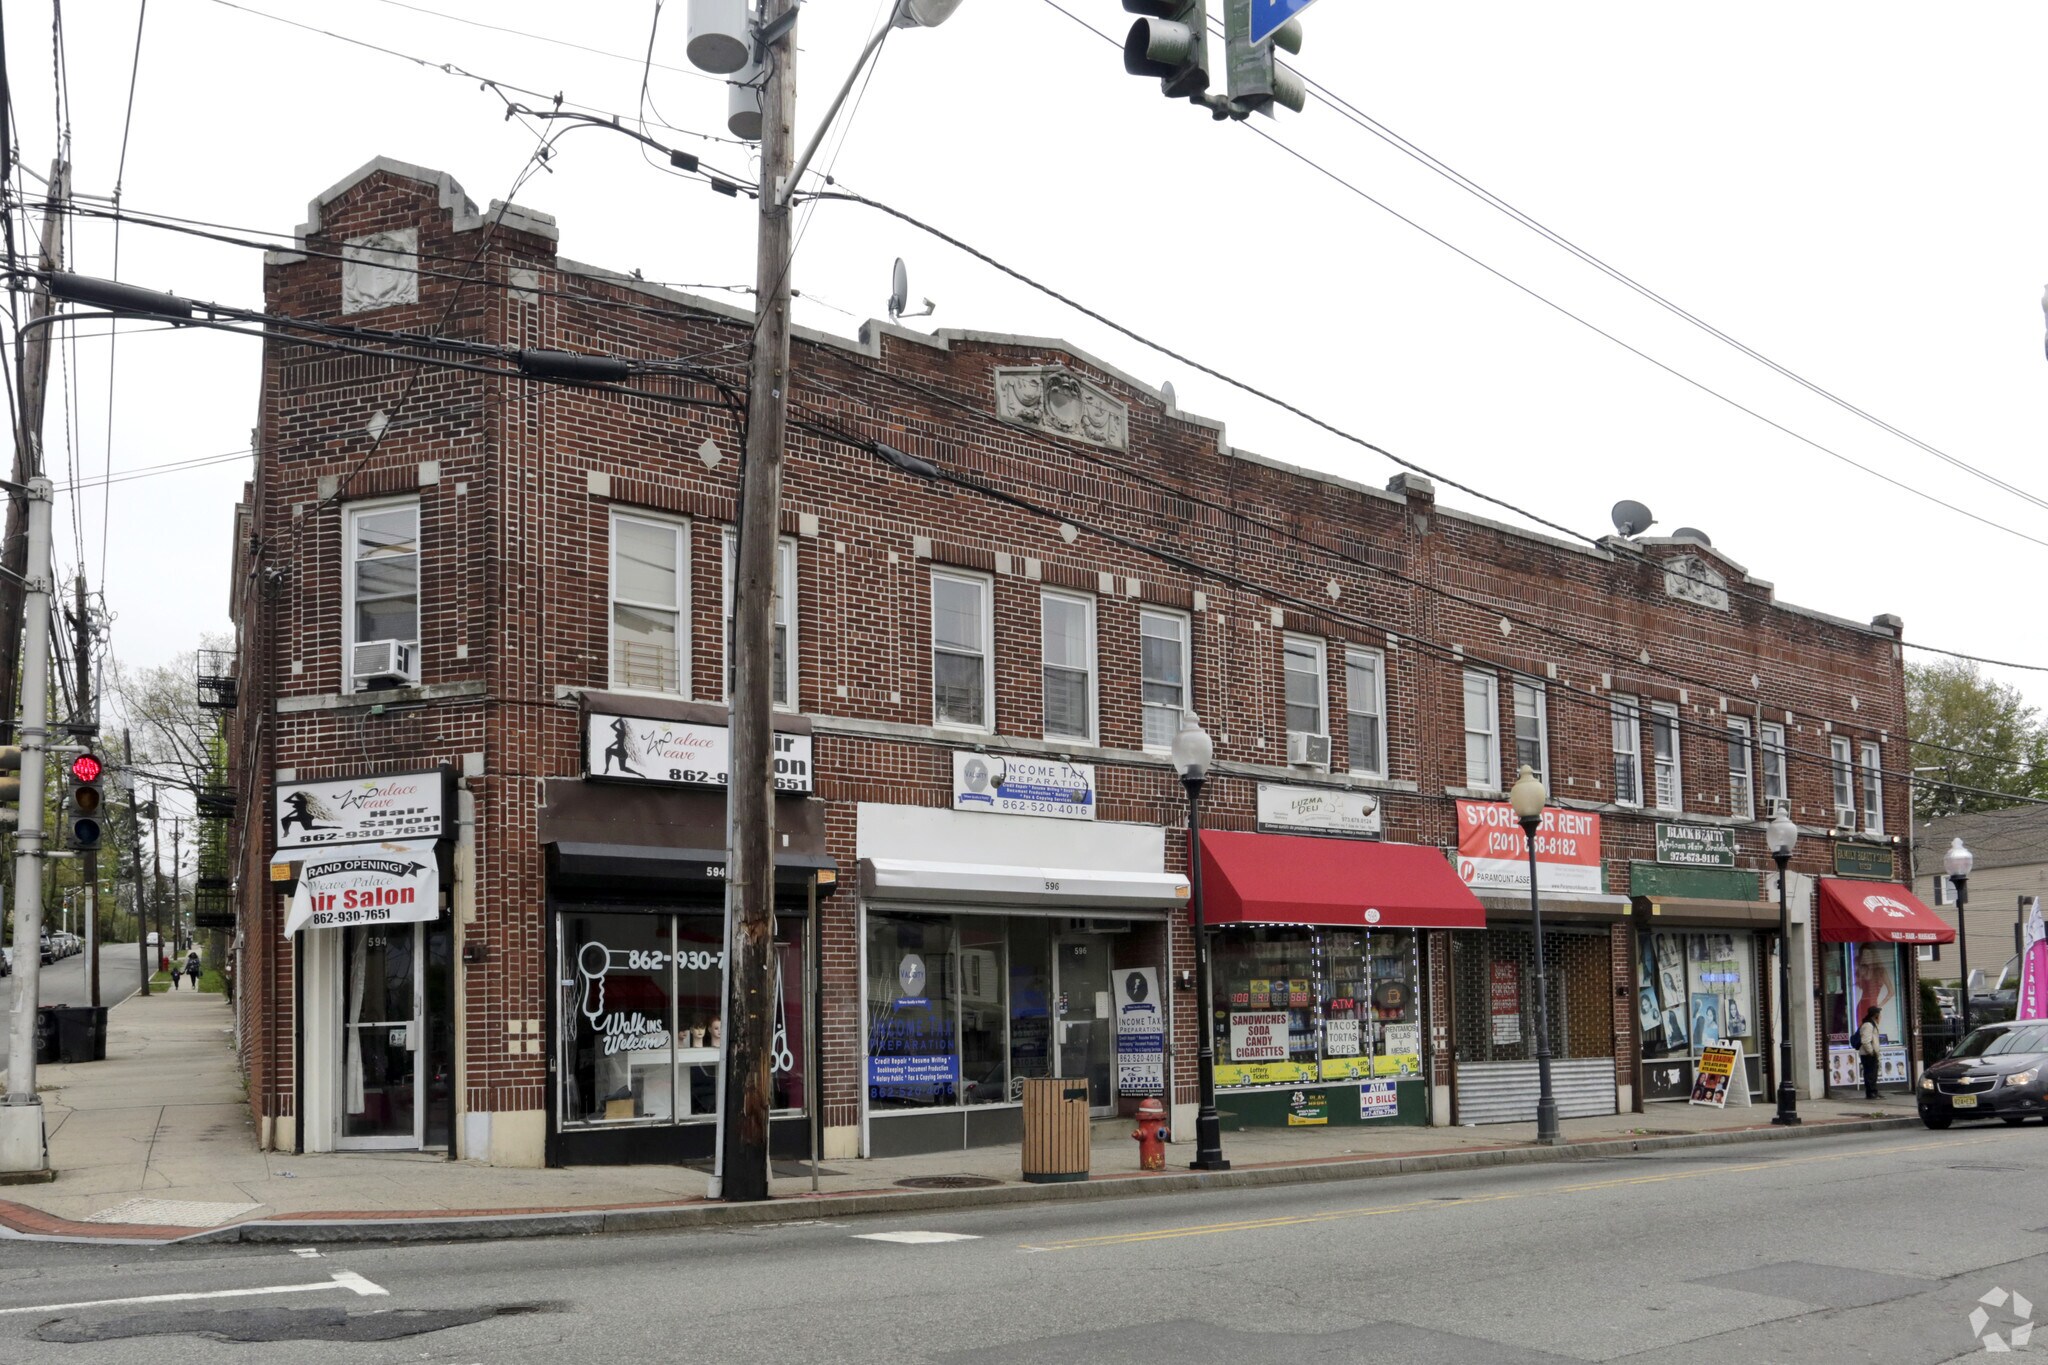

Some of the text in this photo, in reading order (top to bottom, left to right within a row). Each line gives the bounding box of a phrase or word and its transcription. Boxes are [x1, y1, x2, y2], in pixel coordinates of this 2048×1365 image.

[1061, 767, 1085, 780] TAX
[1000, 772, 1088, 788] PREPARATION
[1292, 797, 1323, 810] LUZMA
[369, 806, 428, 818] Hair
[1298, 804, 1319, 815] DELI
[359, 815, 440, 828] Salon
[1466, 804, 1519, 829] STORE
[1558, 813, 1593, 836] RENT
[299, 824, 439, 843] 862-930-7651
[1667, 827, 1724, 842] BLACK BEAUTY
[1488, 832, 1520, 856] (201)
[1658, 838, 1686, 851] African
[1687, 842, 1704, 851] Hair
[1670, 852, 1720, 863] 973-673-9116
[308, 860, 403, 878] RAND OPENING!
[706, 866, 725, 877] 594
[352, 875, 393, 888] Palace
[1476, 873, 1530, 885] PARAMOUNT ASSE
[1045, 882, 1059, 891] 596
[343, 887, 415, 909] Salon
[313, 908, 391, 925] 862-930-7651
[368, 937, 387, 947] 594
[1074, 947, 1087, 955] 596
[1331, 998, 1354, 1009] ATM
[603, 1012, 662, 1036] Walk INS
[1119, 1016, 1161, 1026] INCOME TAX
[1232, 1014, 1287, 1026] SANDWICHES
[929, 1015, 953, 1037] TAX
[1248, 1025, 1270, 1036] SODA
[1329, 1021, 1357, 1031] TACOS
[1385, 1025, 1416, 1033] RENTAMOS
[1246, 1036, 1272, 1047] CANDY
[1329, 1032, 1358, 1042] TORTAS
[1391, 1032, 1411, 1040] SILLAS
[870, 1039, 954, 1051] PREPARATION
[1330, 1044, 1357, 1055] SOPES
[1120, 1053, 1161, 1062] 862-520-4016
[1236, 1046, 1284, 1058] CIGARETTES
[891, 1057, 907, 1065] Repair
[931, 1056, 947, 1064] Writing
[877, 1066, 904, 1074] Bookkeeping
[1370, 1083, 1388, 1092] ATM
[1375, 1094, 1397, 1104] BILLS
